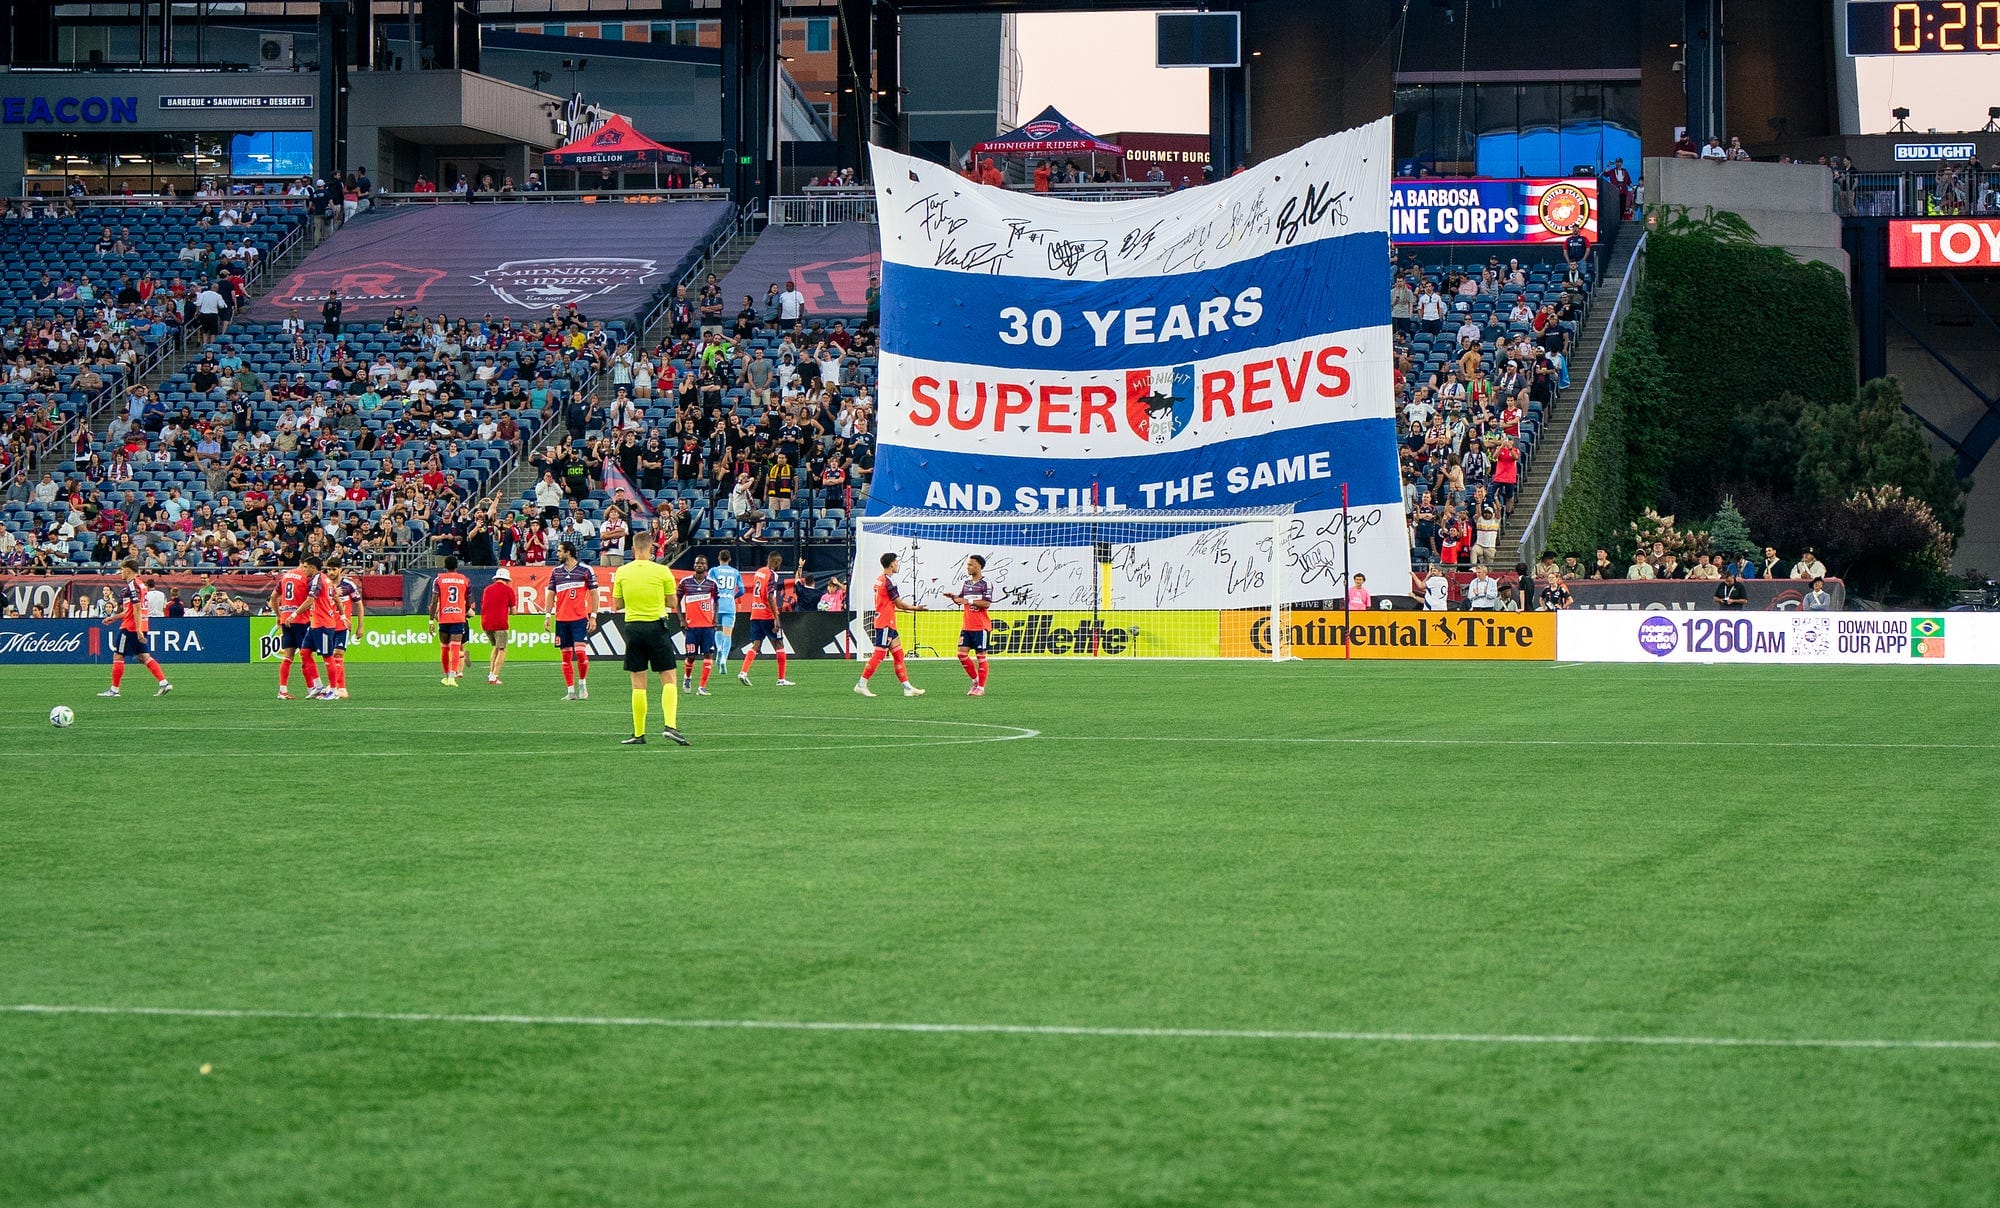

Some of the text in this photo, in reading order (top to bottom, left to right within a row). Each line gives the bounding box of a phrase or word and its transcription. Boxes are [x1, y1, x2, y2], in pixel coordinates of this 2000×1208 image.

[1893, 2, 2000, 51] 0:20
[2, 96, 138, 123] EACON
[167, 98, 306, 106] BARBEQUE SANDWICHES DESSERTS
[984, 142, 1042, 151] MIDNIGHT
[1046, 141, 1086, 149] RIDERS
[1897, 146, 1972, 158] BUD LIGHT
[576, 154, 623, 163] REBELLION
[1126, 149, 1210, 163] GOURMET BURG
[1407, 189, 1480, 207] BARBOSA
[1437, 207, 1519, 234] CORPS
[1911, 223, 2000, 264] TOY
[501, 267, 638, 276] MIDNIGHT
[514, 277, 609, 285] RIDERS
[998, 286, 1264, 347] 30 YEARS
[909, 345, 1351, 434] SUPER REVS
[1132, 371, 1191, 391] MIDNIGHT
[682, 453, 691, 465] 11
[924, 451, 1332, 514] AND STILL THE SAME
[285, 581, 294, 601] 8
[717, 575, 736, 590] 30
[754, 580, 761, 597] 2
[448, 585, 458, 603] 3
[569, 588, 576, 599] 9
[701, 601, 711, 612] 80
[986, 614, 1129, 655] Gillette
[1457, 618, 1533, 648] Tire
[1682, 618, 1786, 653] 1260 AM
[1838, 620, 1908, 634] DOWNLOAD
[0, 630, 203, 653] Michelob UTRA
[366, 629, 437, 646] Quicker
[1838, 635, 1907, 653] OUR APP
